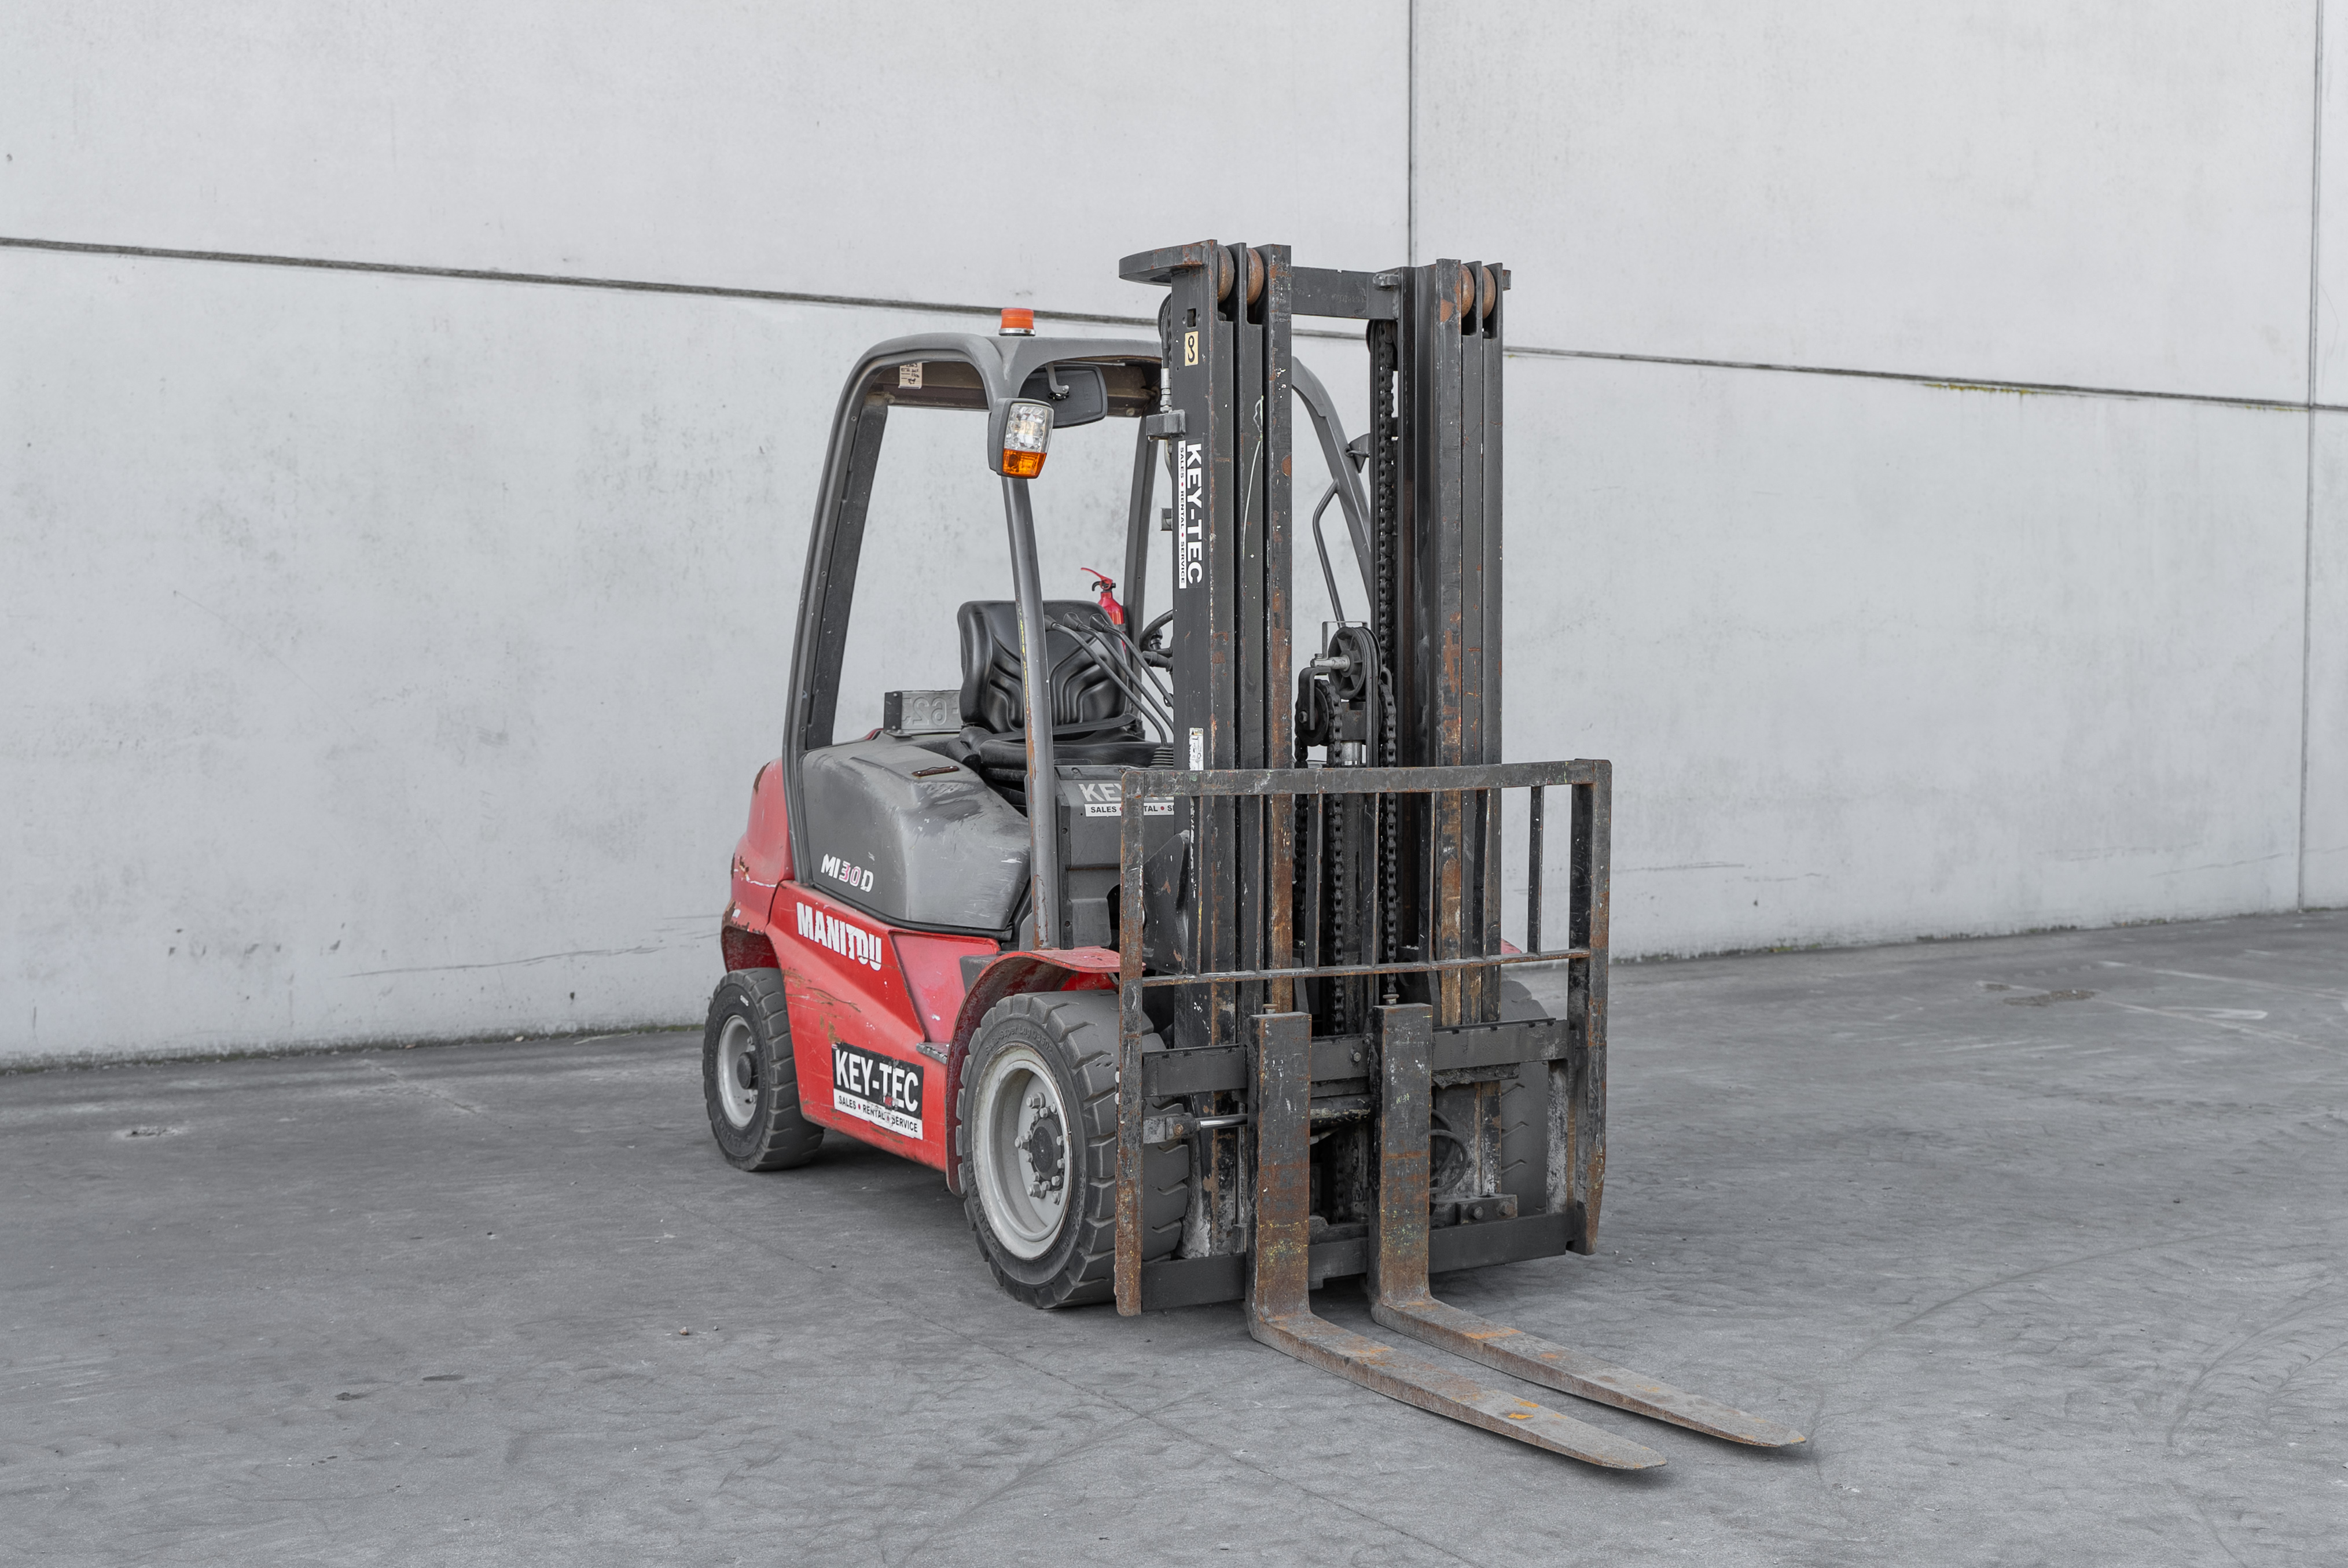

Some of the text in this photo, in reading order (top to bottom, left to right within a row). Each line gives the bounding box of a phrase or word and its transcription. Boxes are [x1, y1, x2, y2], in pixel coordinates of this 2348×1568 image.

[1187, 443, 1203, 584] KEY-TEC
[796, 901, 881, 971] MANITOU
[835, 1049, 919, 1112] KEY-TEC
[839, 1095, 917, 1132] SALES RENTAL SERVICE
